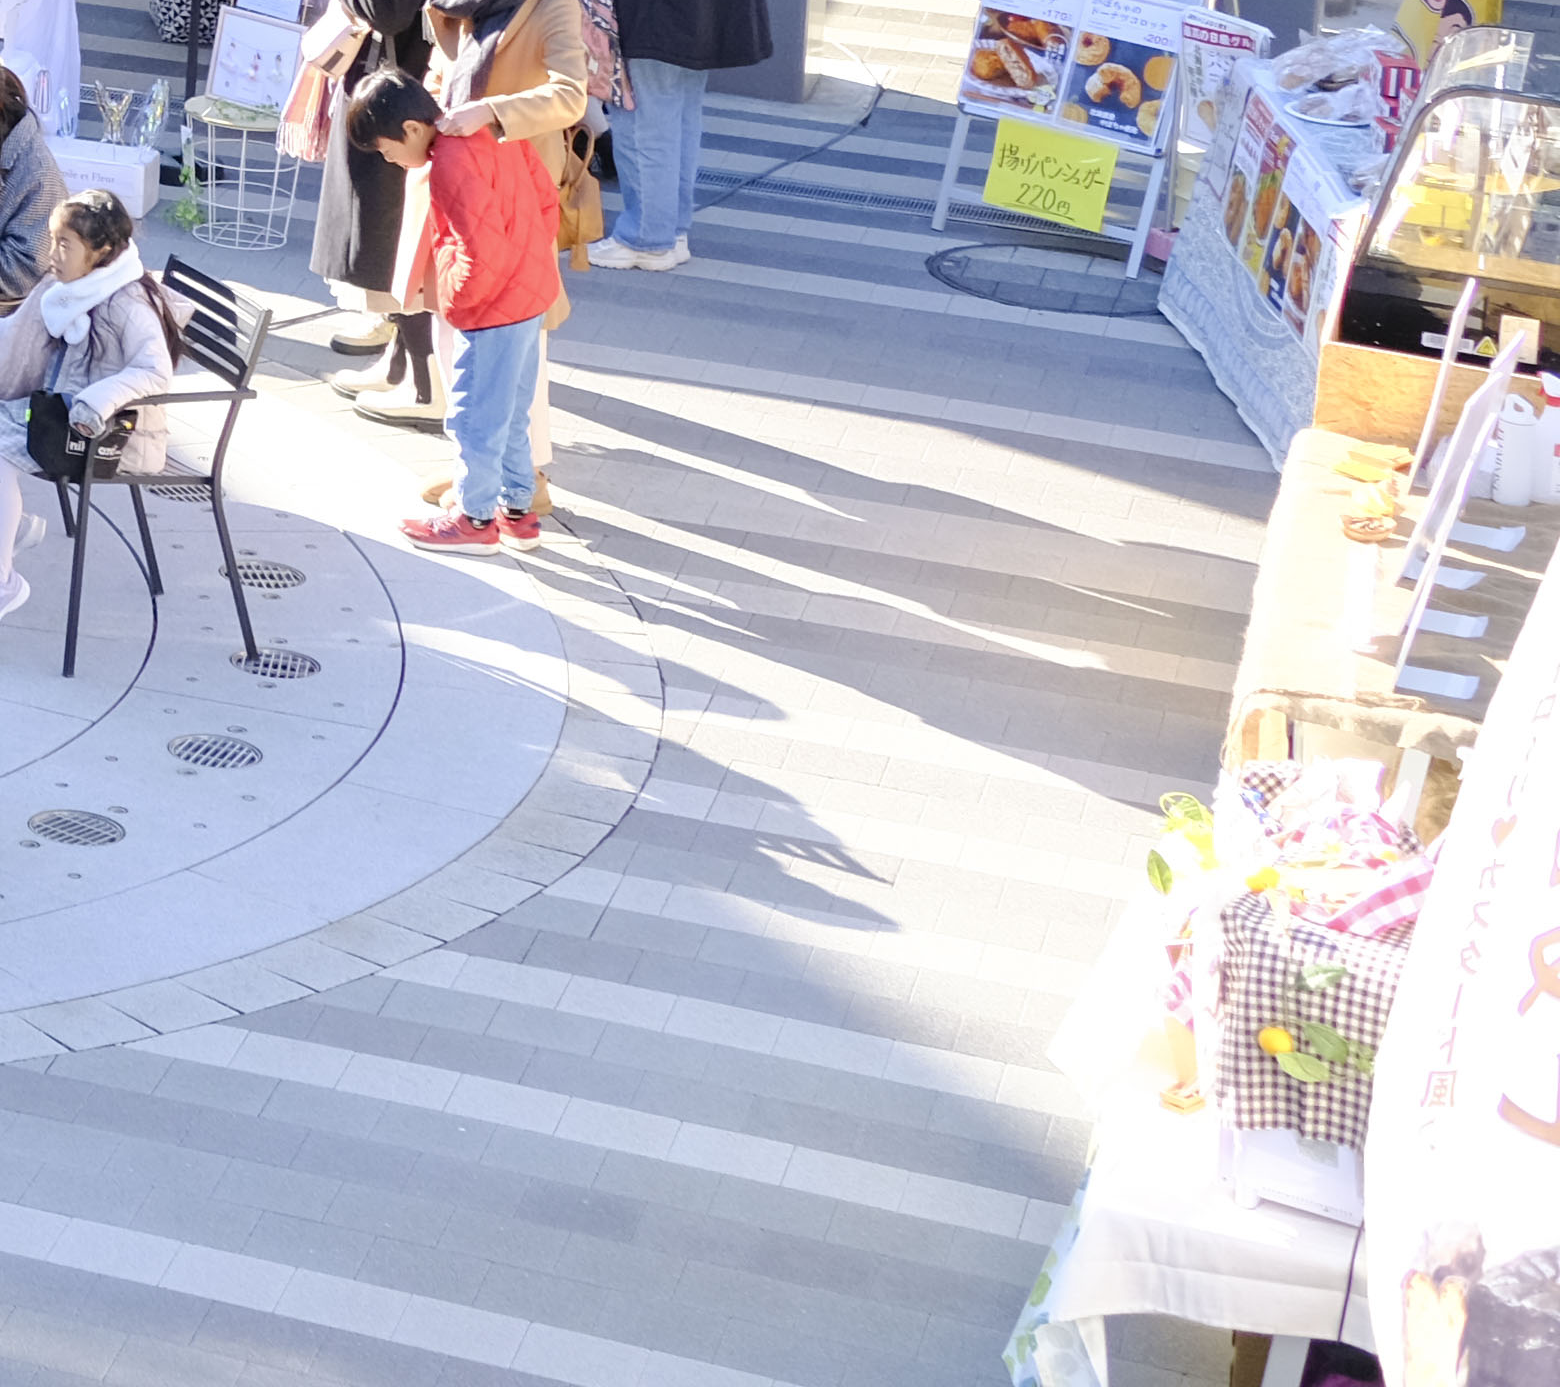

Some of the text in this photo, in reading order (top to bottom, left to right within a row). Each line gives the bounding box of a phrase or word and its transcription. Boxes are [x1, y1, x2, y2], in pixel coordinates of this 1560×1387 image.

[999, 142, 1105, 190] 揚げパンシュガー
[1016, 182, 1072, 216] 220円
